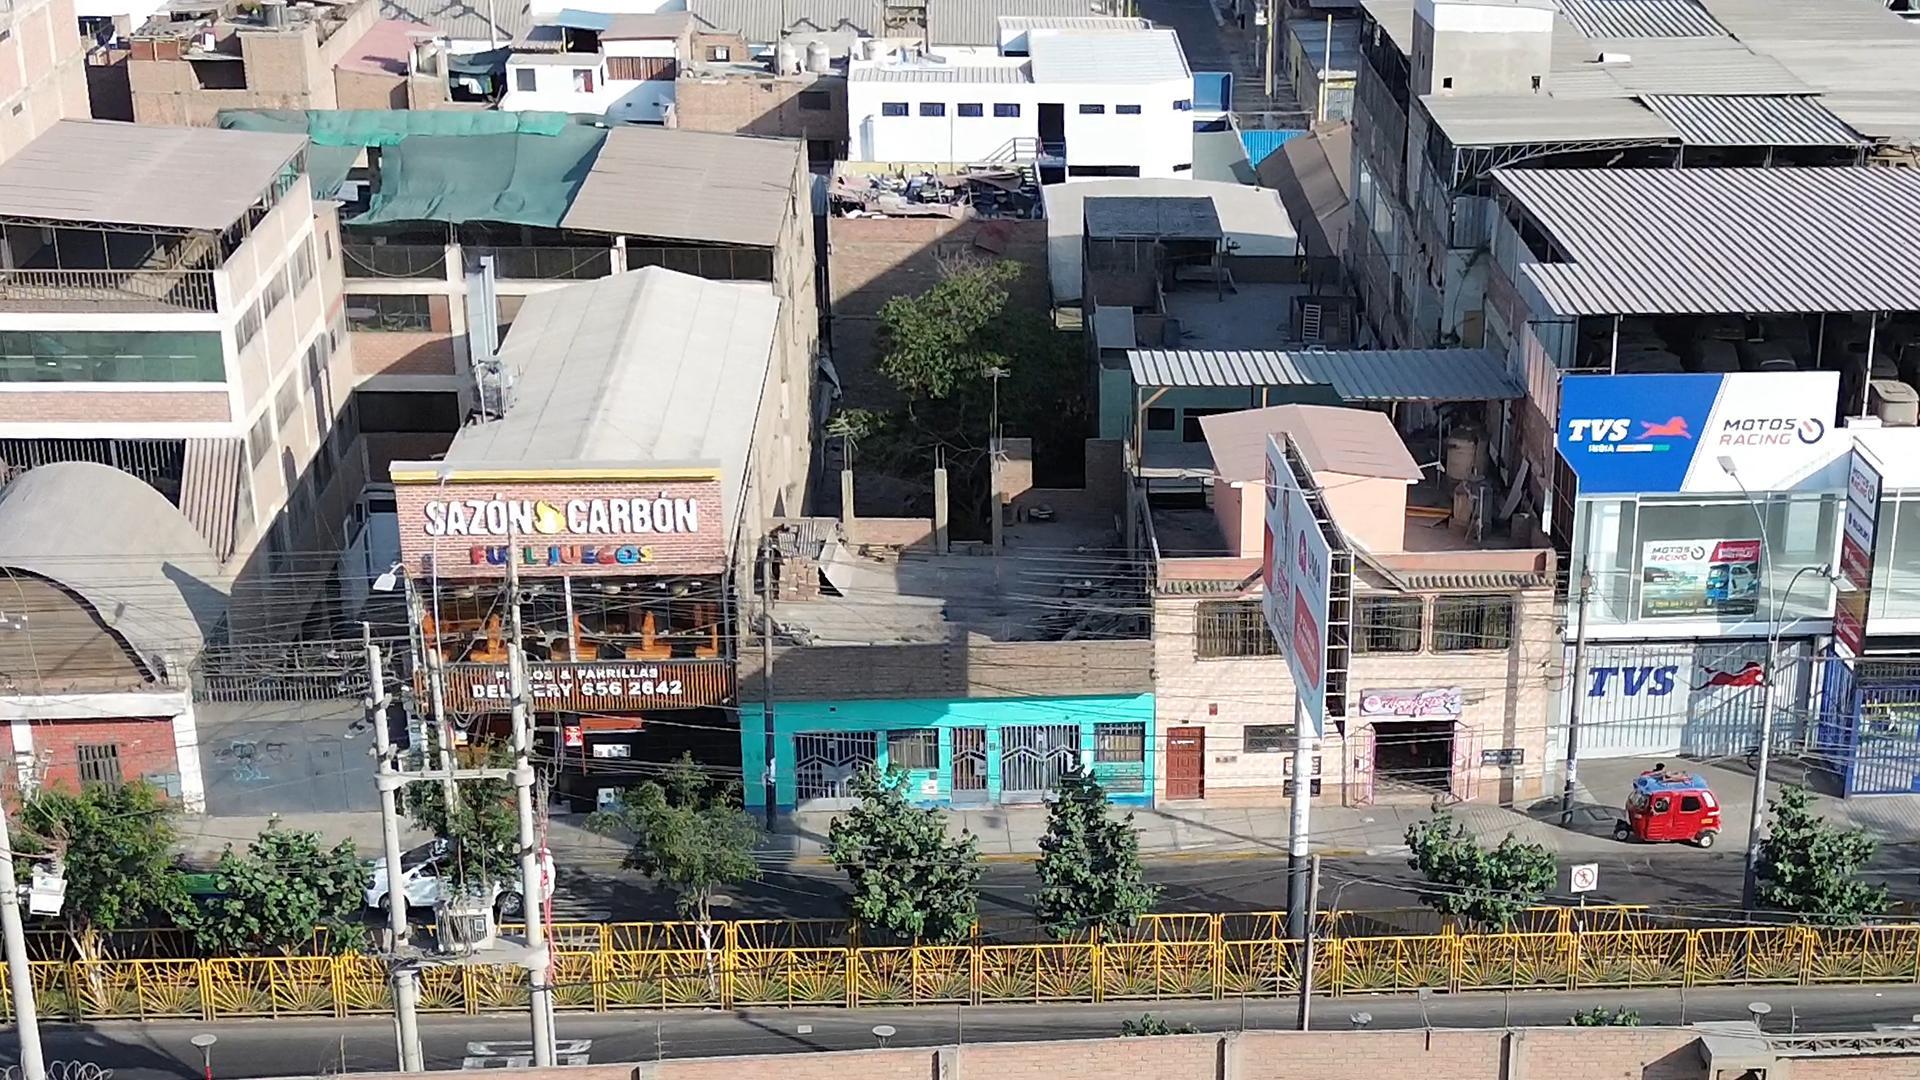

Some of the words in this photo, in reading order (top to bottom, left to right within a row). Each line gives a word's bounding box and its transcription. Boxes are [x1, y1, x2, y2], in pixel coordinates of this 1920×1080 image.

[1568, 419, 1630, 442] TVS
[1723, 418, 1797, 431] MOTOS
[1719, 433, 1791, 446] RACING
[424, 493, 532, 535] SAZÓN
[566, 491, 698, 534] CARBÓN
[470, 545, 539, 565] FUL
[547, 544, 654, 566] JUEGOS
[1651, 546, 1691, 554] MOTOS
[560, 670, 571, 680] &
[577, 668, 658, 679] PARRILLAS
[1587, 666, 1679, 697] TVS
[472, 683, 573, 699] DELERY
[581, 681, 622, 696] 656
[628, 680, 682, 695] 2642
